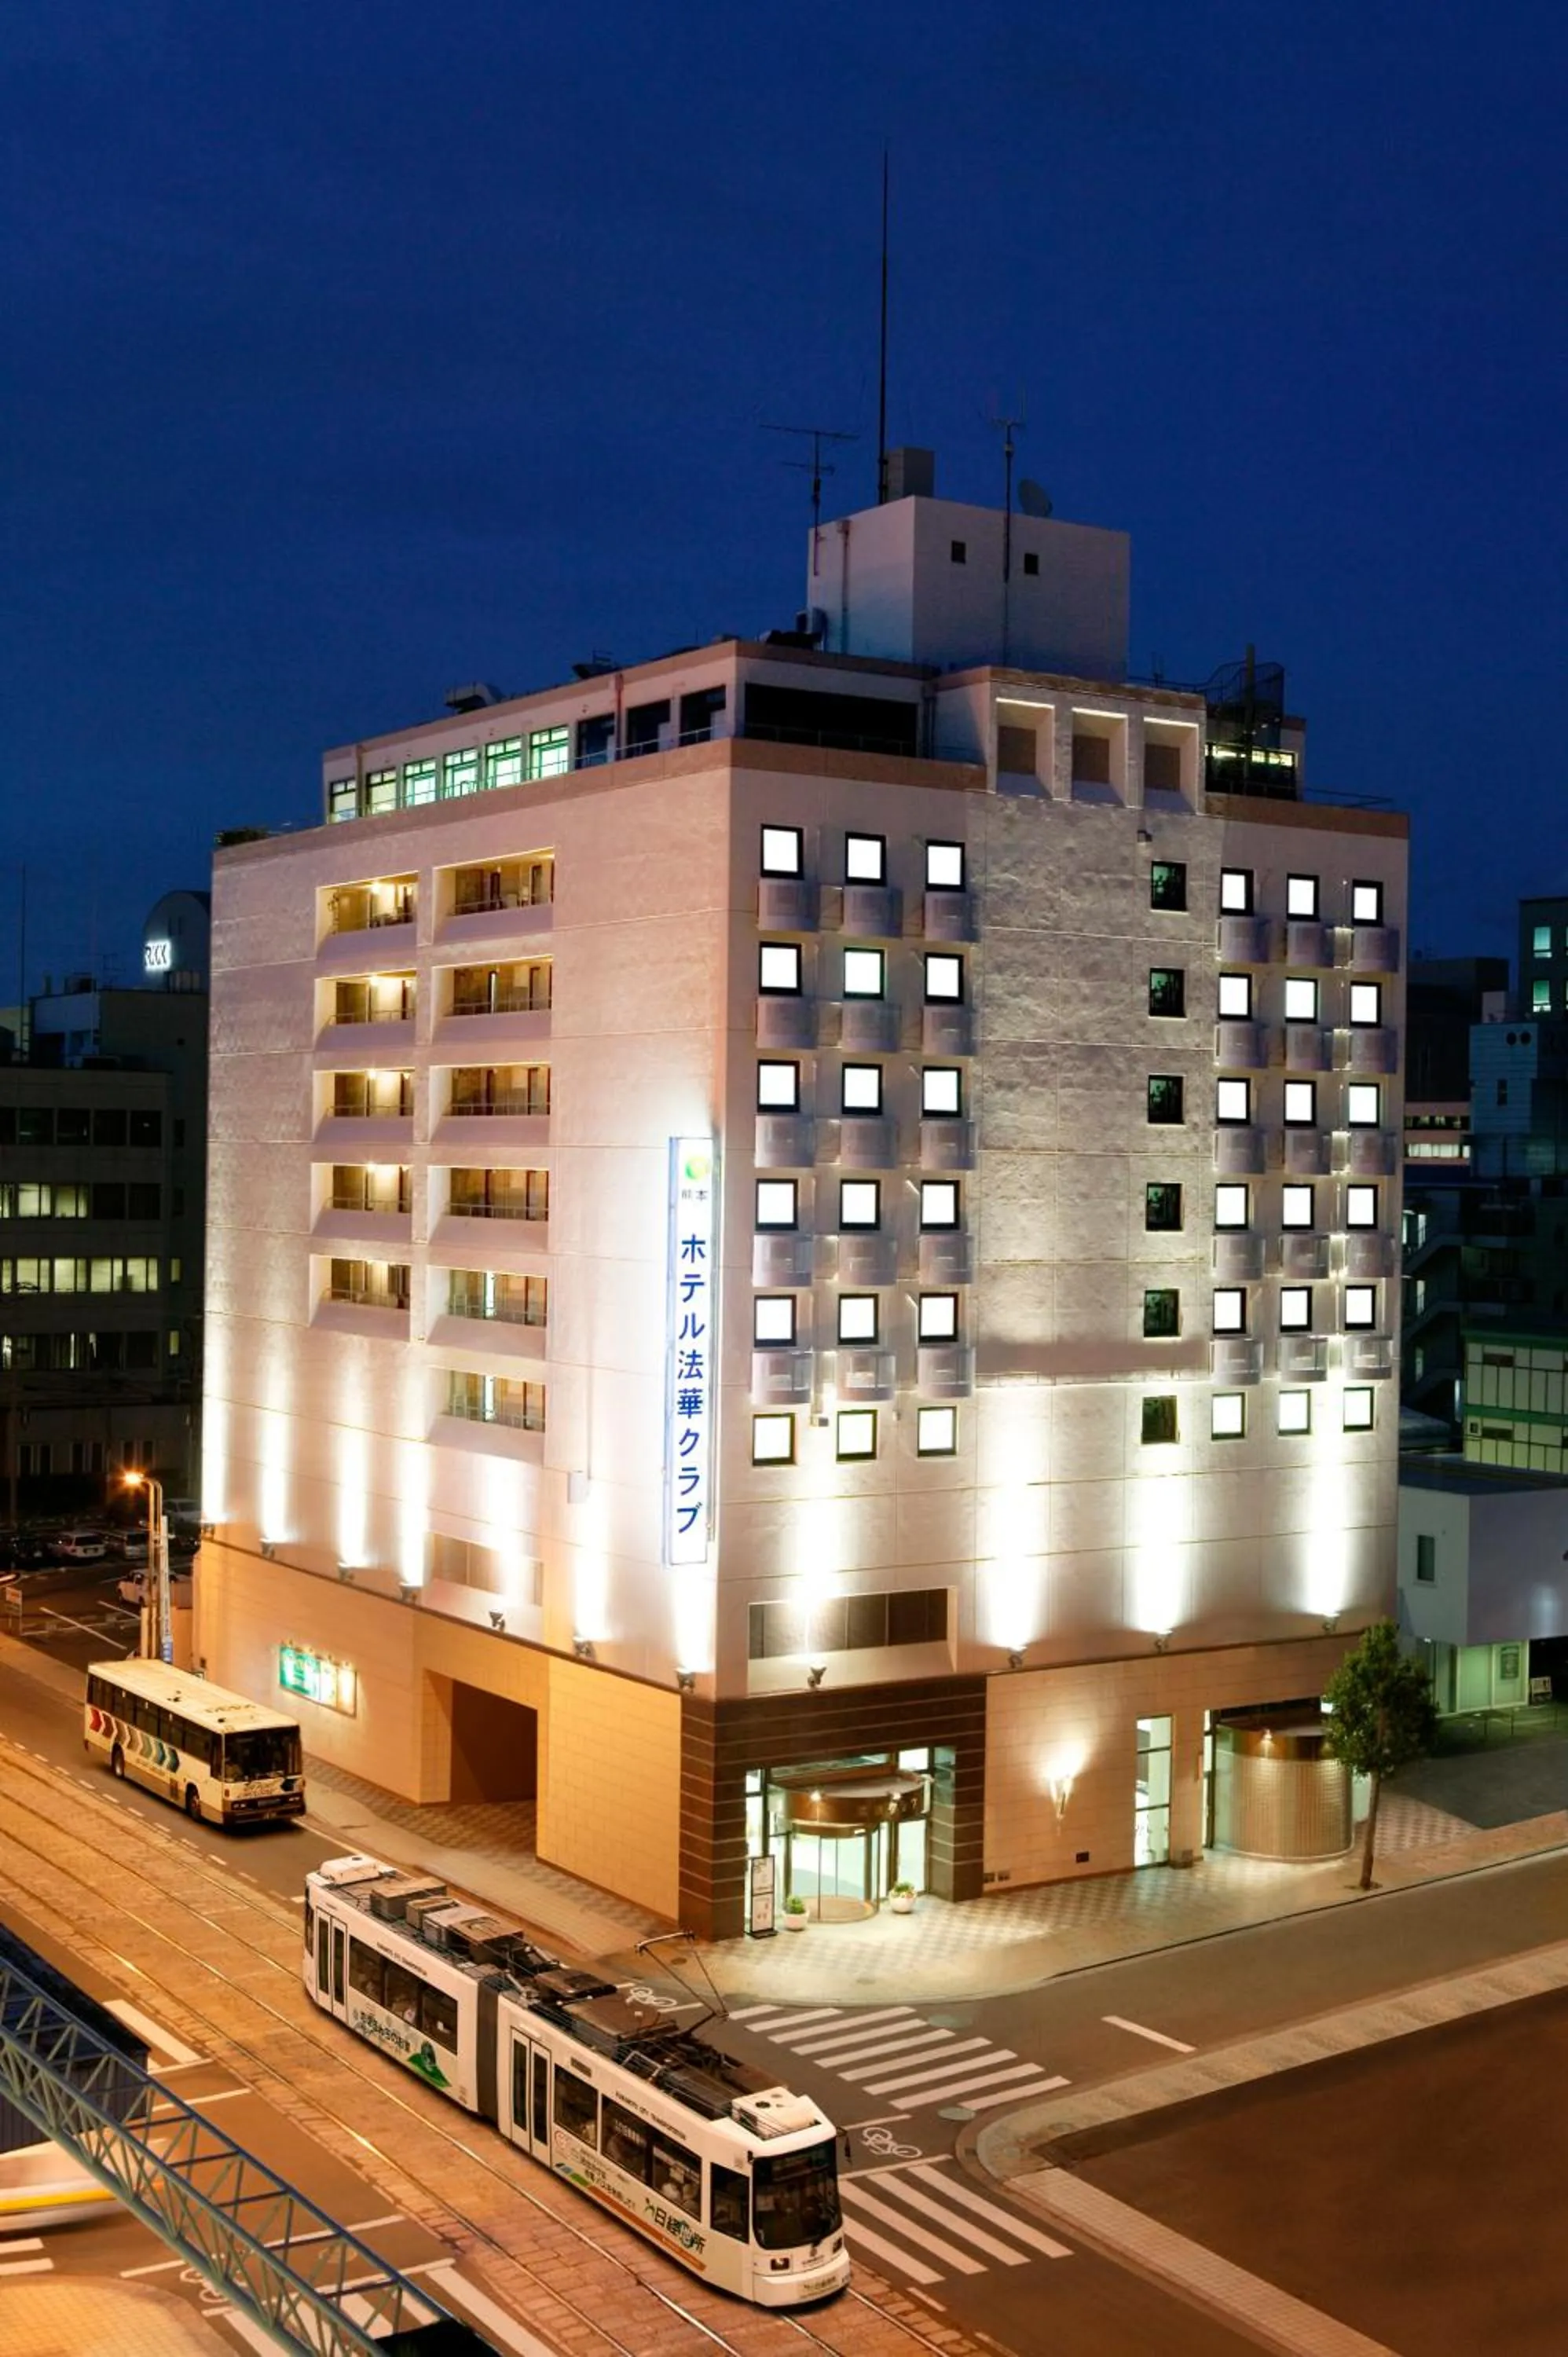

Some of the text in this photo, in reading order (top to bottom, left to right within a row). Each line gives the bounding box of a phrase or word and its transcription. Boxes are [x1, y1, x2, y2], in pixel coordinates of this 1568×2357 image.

[677, 1233, 706, 1533] ホテル法華クラブ
